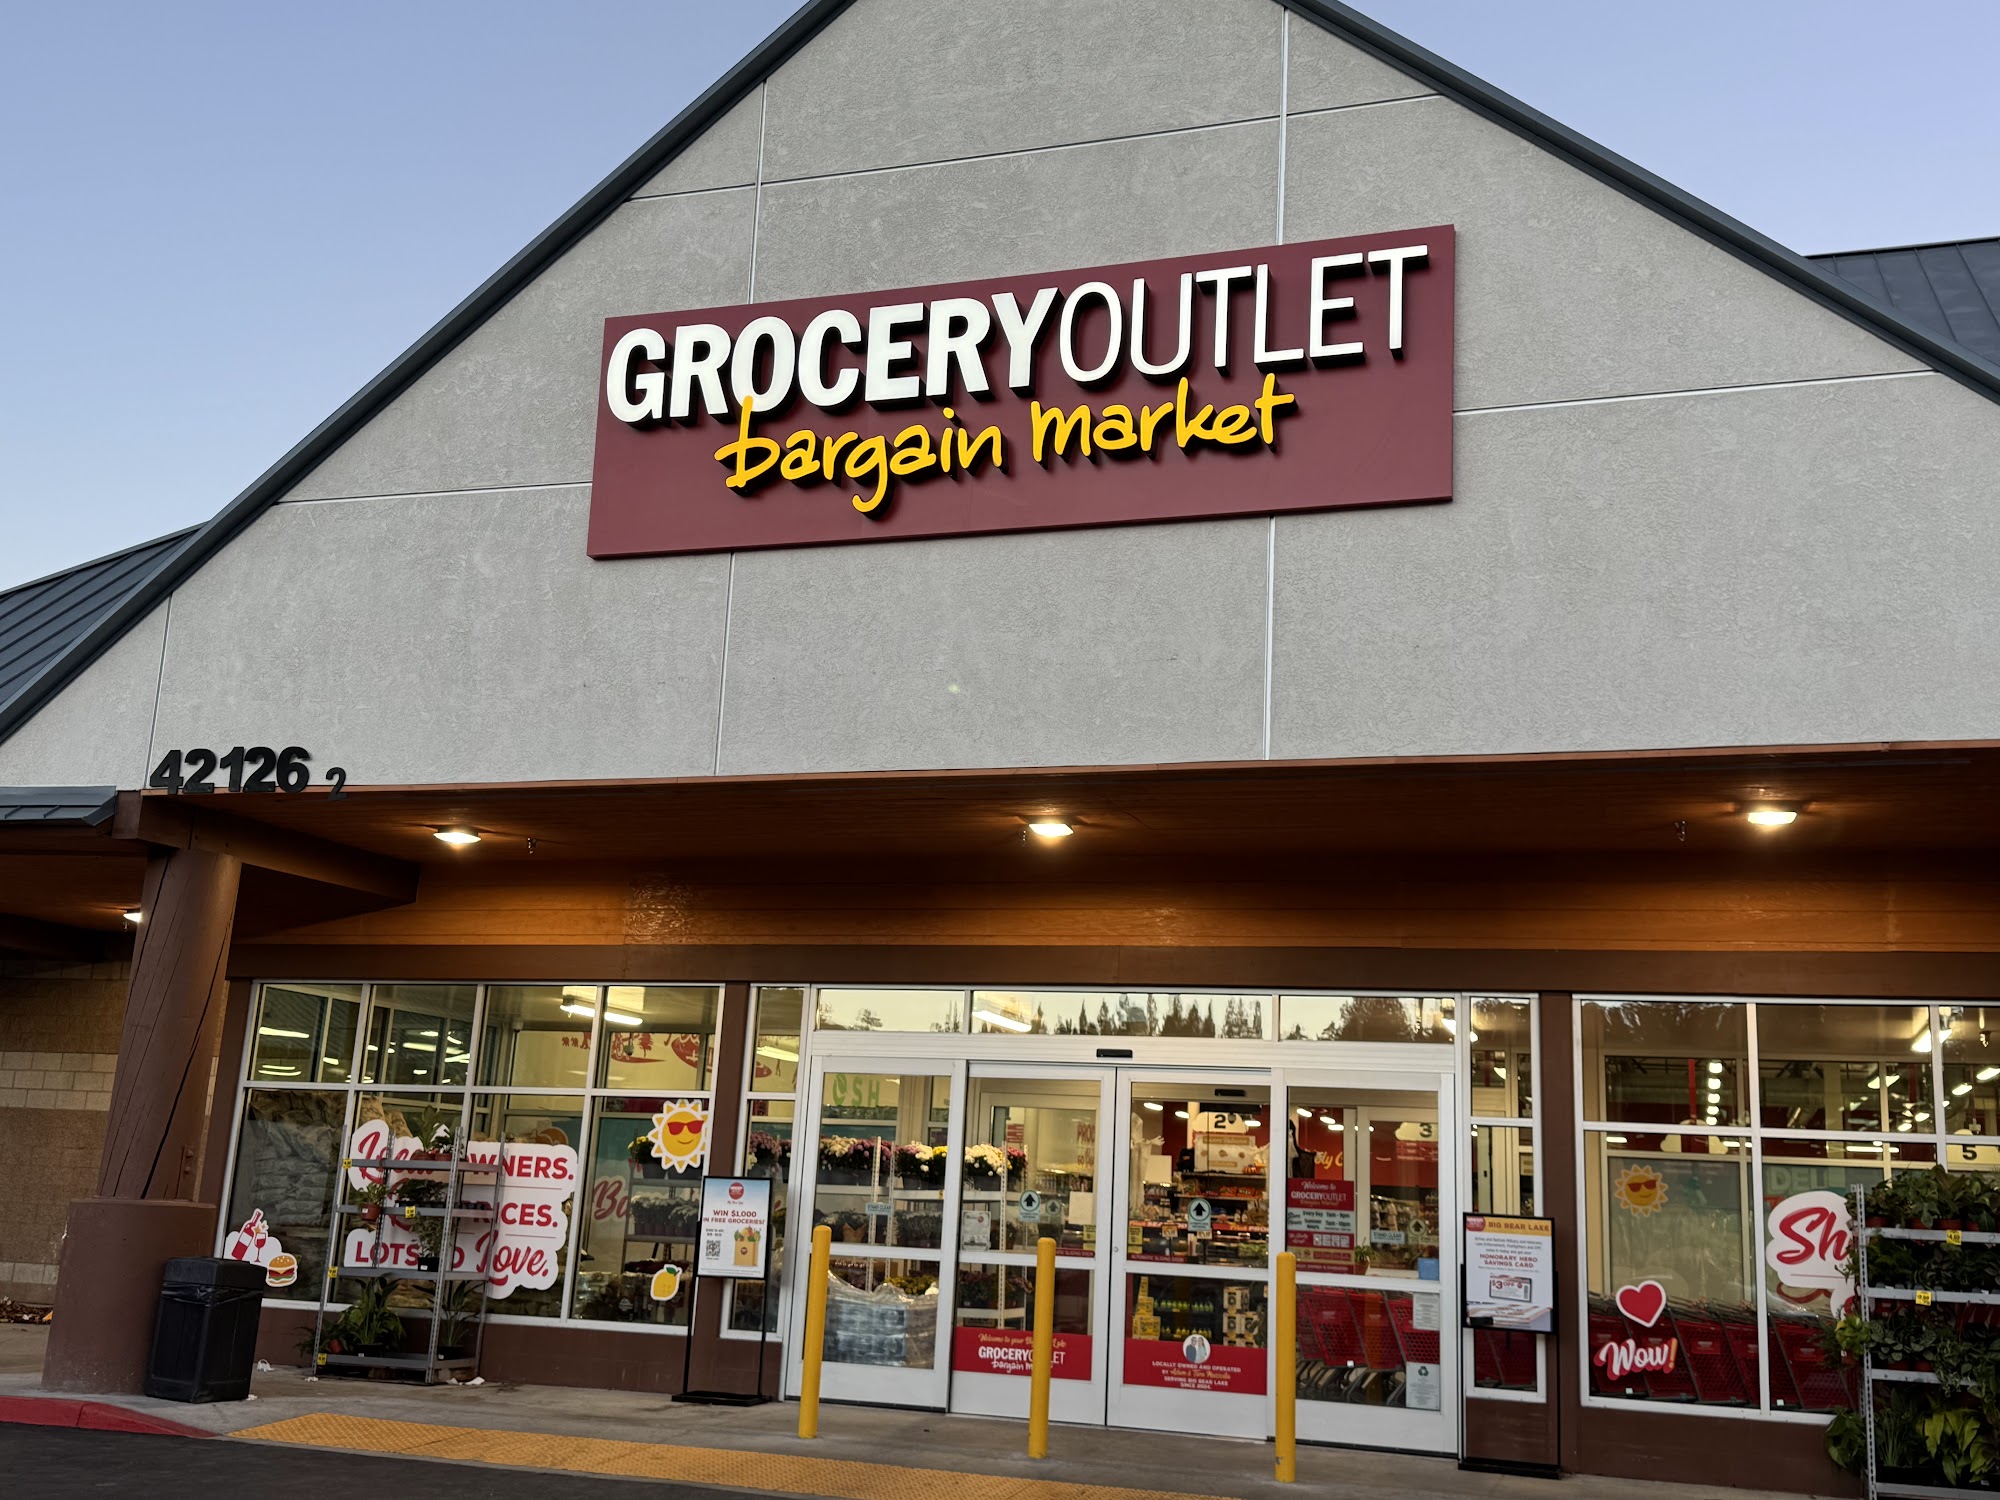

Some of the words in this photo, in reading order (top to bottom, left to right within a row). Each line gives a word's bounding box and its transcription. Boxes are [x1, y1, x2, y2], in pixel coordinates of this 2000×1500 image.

[714, 396, 1002, 513] bargain
[1030, 373, 1295, 462] market
[150, 746, 311, 795] 42126
[326, 767, 348, 800] 2
[1214, 1114, 1226, 1129] 2
[1419, 1122, 1433, 1138] 3
[1962, 1144, 1978, 1160] 5
[467, 1152, 574, 1180] WNERS.
[1301, 1181, 1329, 1190] Welcome
[731, 1210, 757, 1218] $1,000
[1528, 1224, 1550, 1232] LAKE
[355, 1241, 420, 1266] LOTS
[475, 1229, 549, 1286] Love.
[1595, 1337, 1678, 1380] Wow!
[1212, 1365, 1242, 1373] OPERATED
